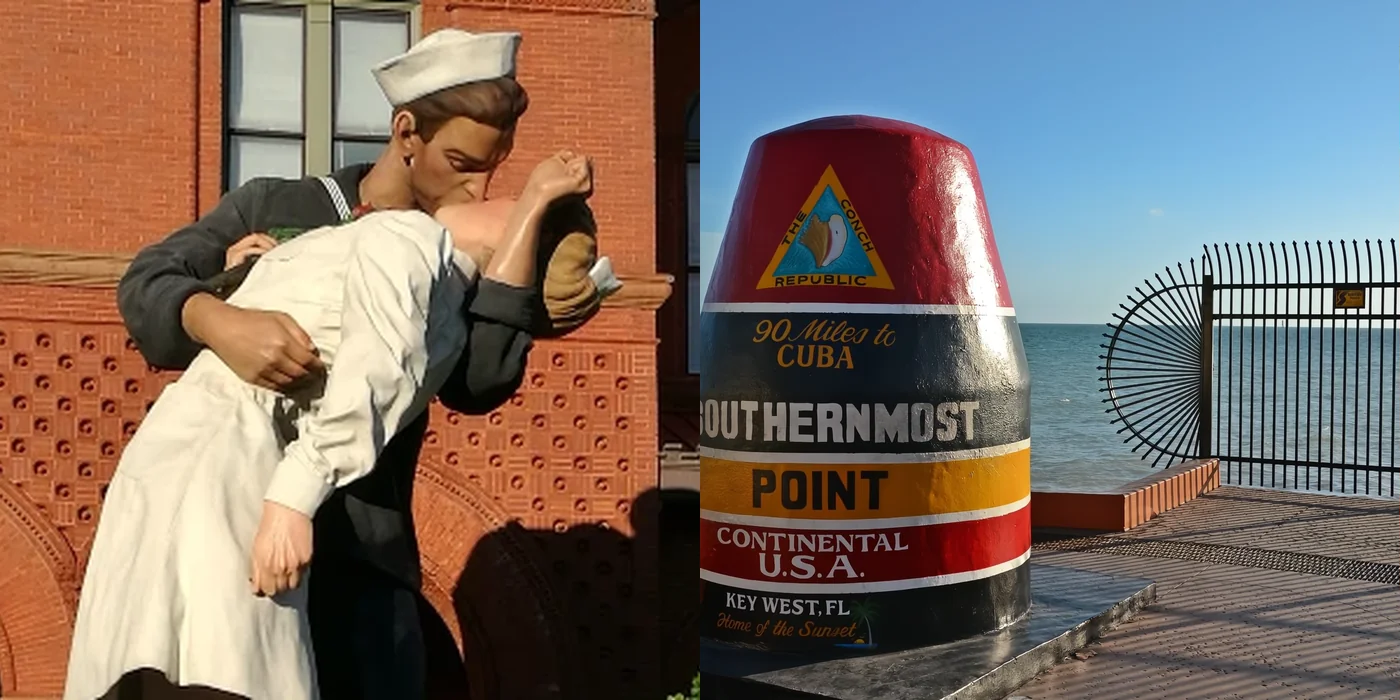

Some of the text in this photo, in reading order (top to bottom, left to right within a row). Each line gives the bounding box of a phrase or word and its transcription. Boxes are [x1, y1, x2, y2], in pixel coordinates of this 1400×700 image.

[781, 199, 875, 253] THE CONCH
[774, 274, 868, 287] REPUBLIC
[752, 318, 897, 347] 90 Miles to
[776, 344, 855, 370] CUBA
[751, 468, 889, 511] POINT
[716, 526, 910, 553] CONTINENTAL
[758, 552, 866, 579] U.S.A.
[726, 591, 758, 613] KEY
[717, 612, 858, 638] Home of the Sunset
